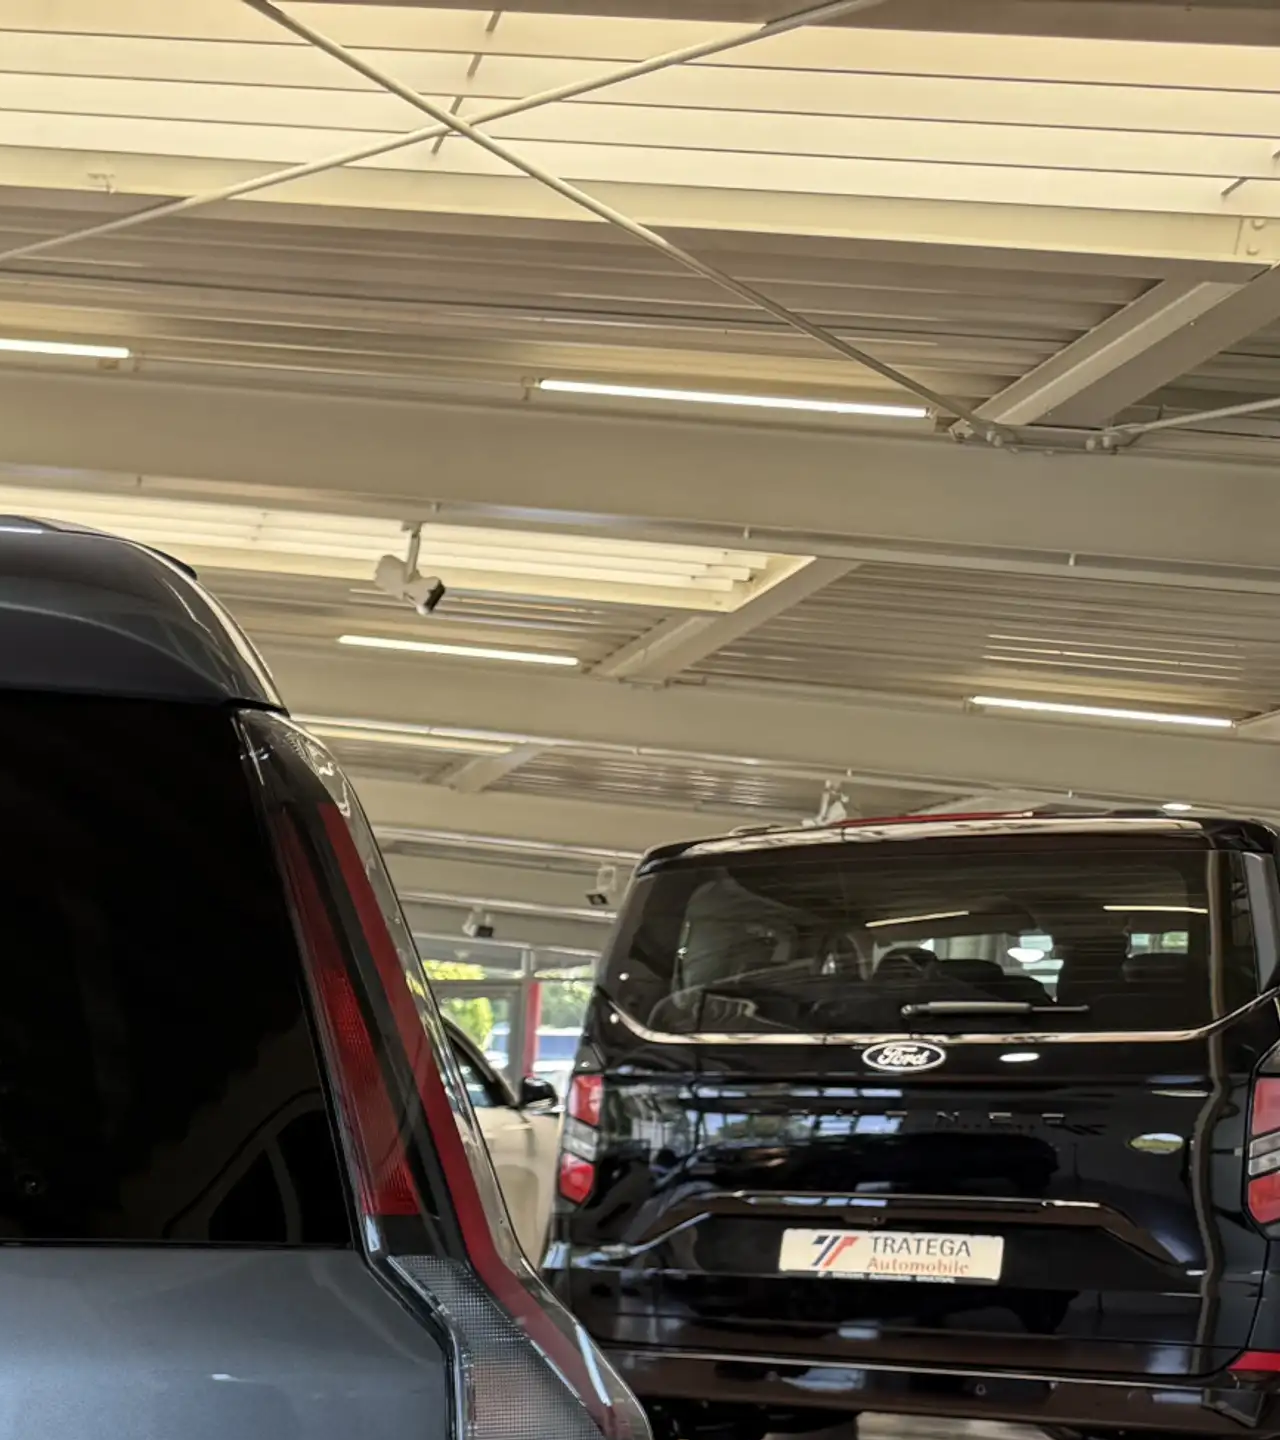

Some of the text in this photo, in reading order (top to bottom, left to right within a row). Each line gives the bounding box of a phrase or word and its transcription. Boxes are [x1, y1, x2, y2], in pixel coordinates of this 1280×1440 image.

[877, 1046, 930, 1066] Ford
[869, 1236, 971, 1257] TRATEGA
[867, 1257, 969, 1274] Automobile
